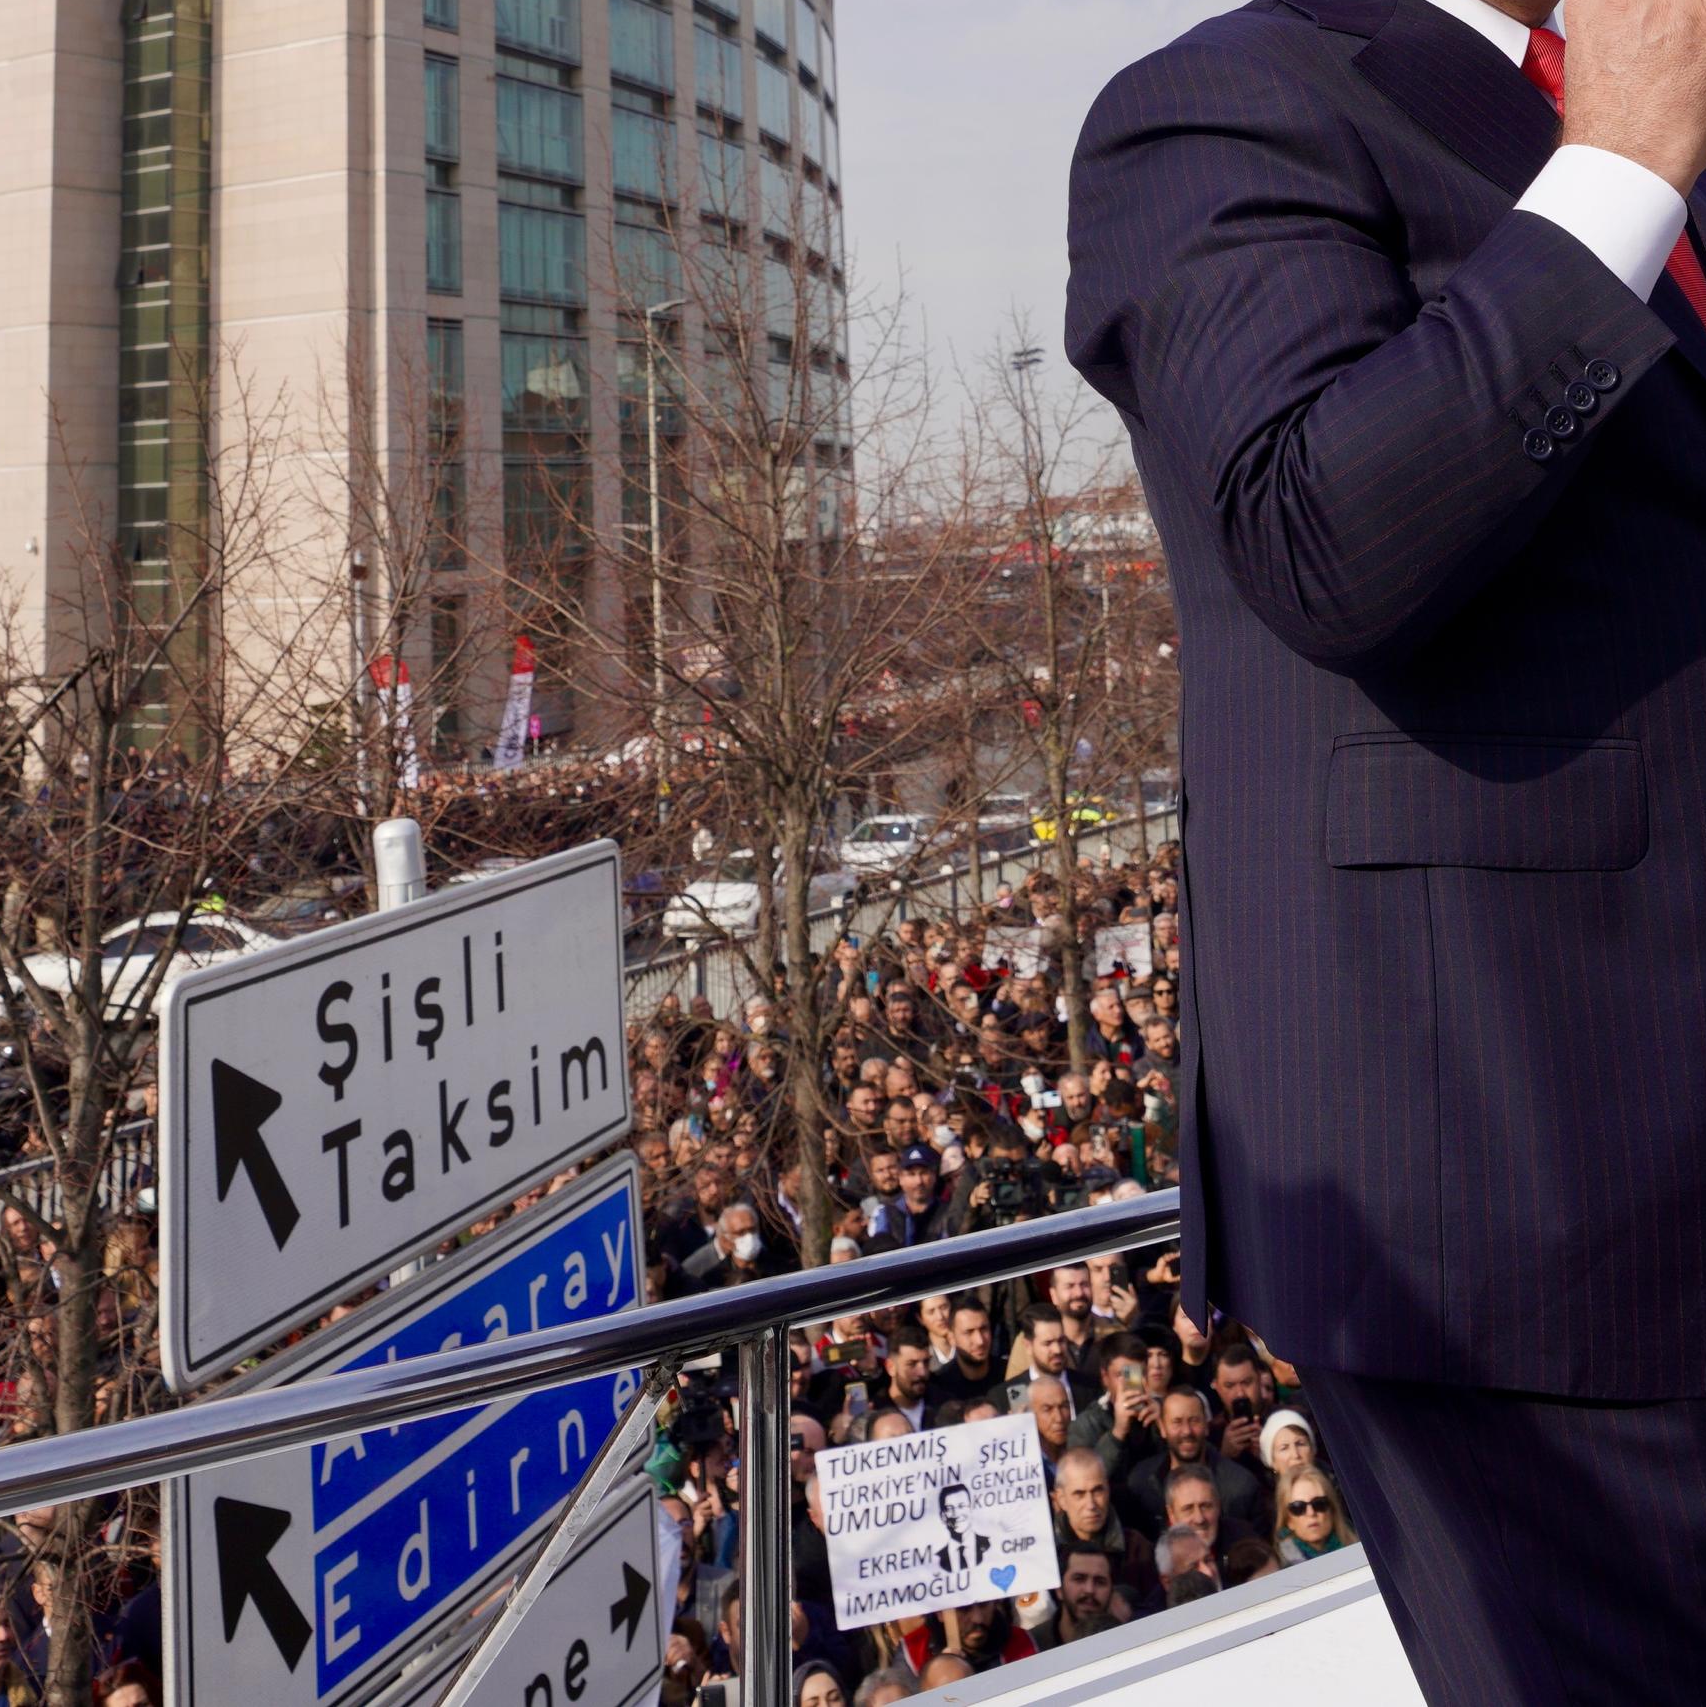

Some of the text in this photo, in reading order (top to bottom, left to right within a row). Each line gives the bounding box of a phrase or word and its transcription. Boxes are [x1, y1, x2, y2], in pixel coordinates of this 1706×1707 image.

[316, 931, 506, 1102] Şişli
[321, 1035, 609, 1229] Taksim
[827, 1434, 948, 1480] TÜKENMİŞ
[978, 1432, 1027, 1469] ŞİŞLİ
[827, 1463, 962, 1511] TÜRKİYE'NİN
[971, 1463, 1040, 1490] GENÇLİK
[972, 1483, 1042, 1510] KOLLARI
[324, 1366, 636, 1666] Edirne
[827, 1497, 926, 1537] UMUDU
[858, 1544, 933, 1580] EKREM
[1001, 1536, 1036, 1554] CHP
[845, 1570, 971, 1617] İMAMOĞLU
